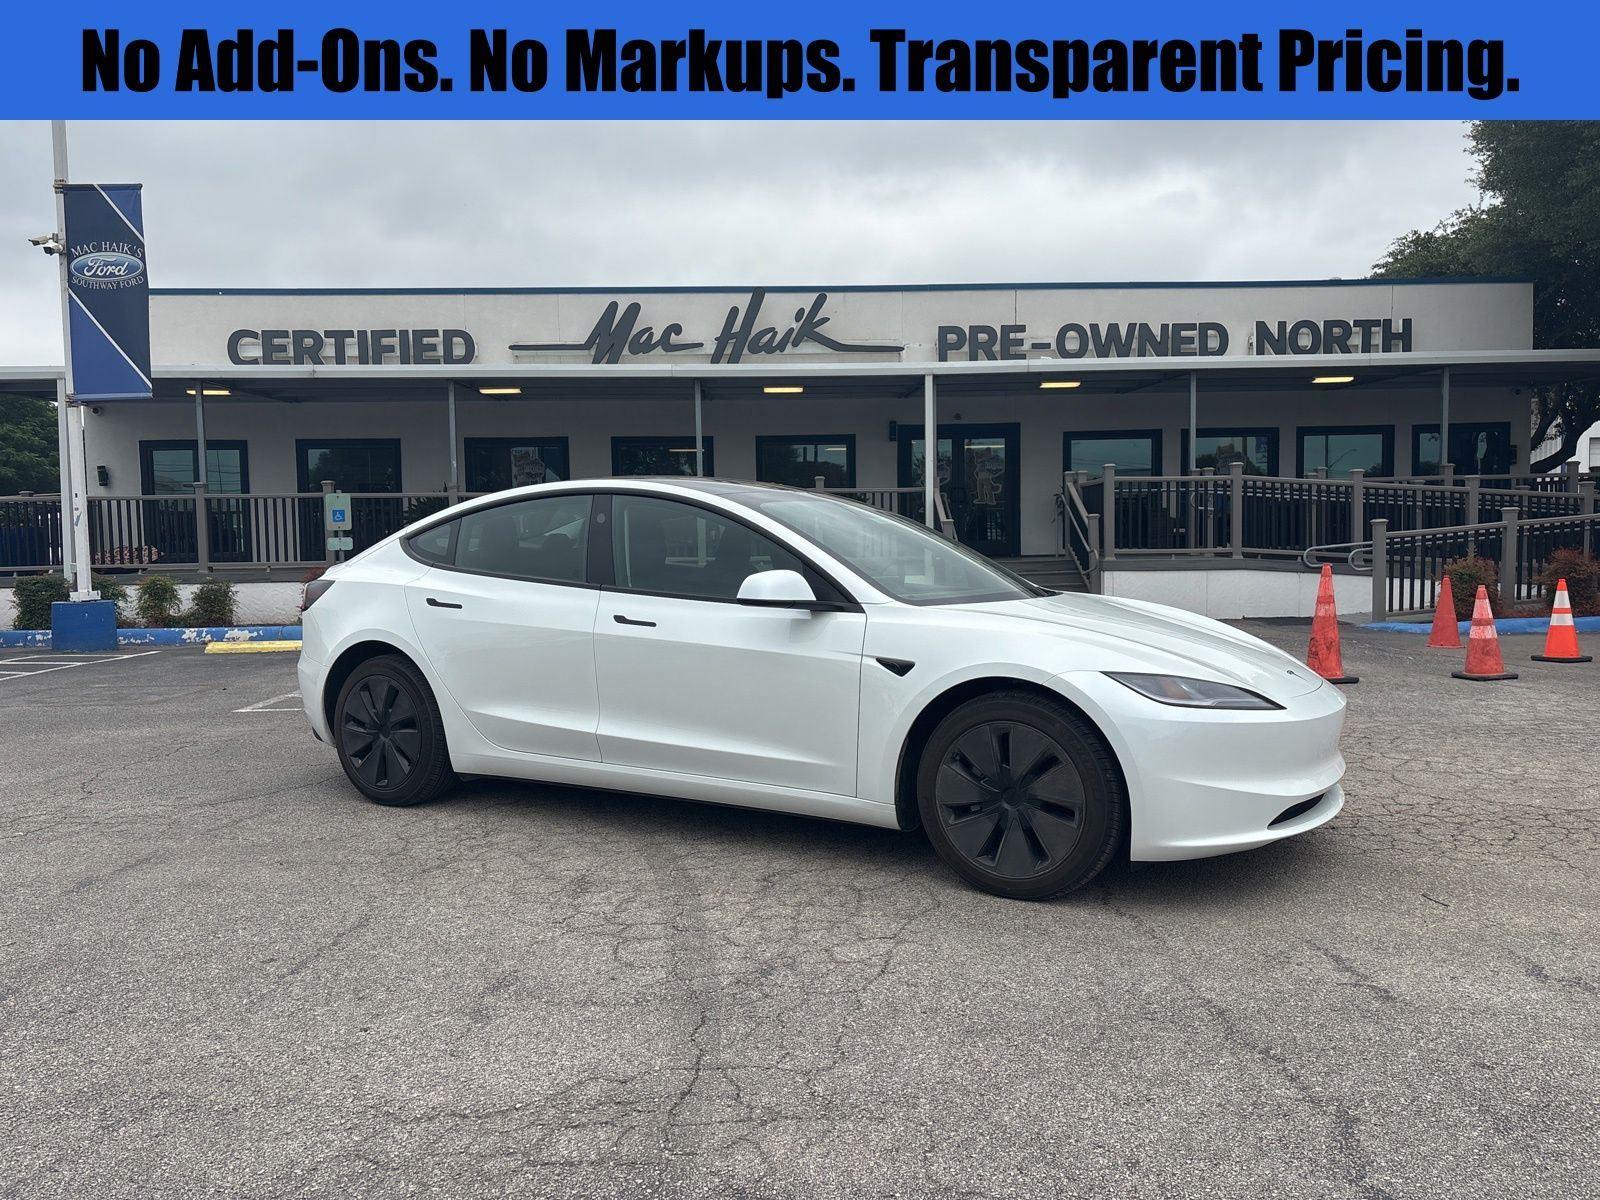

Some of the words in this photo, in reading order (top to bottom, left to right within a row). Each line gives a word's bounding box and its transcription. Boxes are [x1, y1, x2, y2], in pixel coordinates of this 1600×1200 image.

[71, 241, 98, 258] MAC
[101, 241, 144, 259] HAIK'S
[83, 256, 129, 277] Ford
[71, 275, 118, 290] SOUTHWAY
[120, 275, 144, 289] FORD
[508, 300, 704, 364] Mac
[710, 287, 905, 364] Haik
[938, 321, 1229, 362] PRE-OWNED
[1255, 317, 1413, 356] NORTH
[227, 329, 476, 365] CERTIFIED
